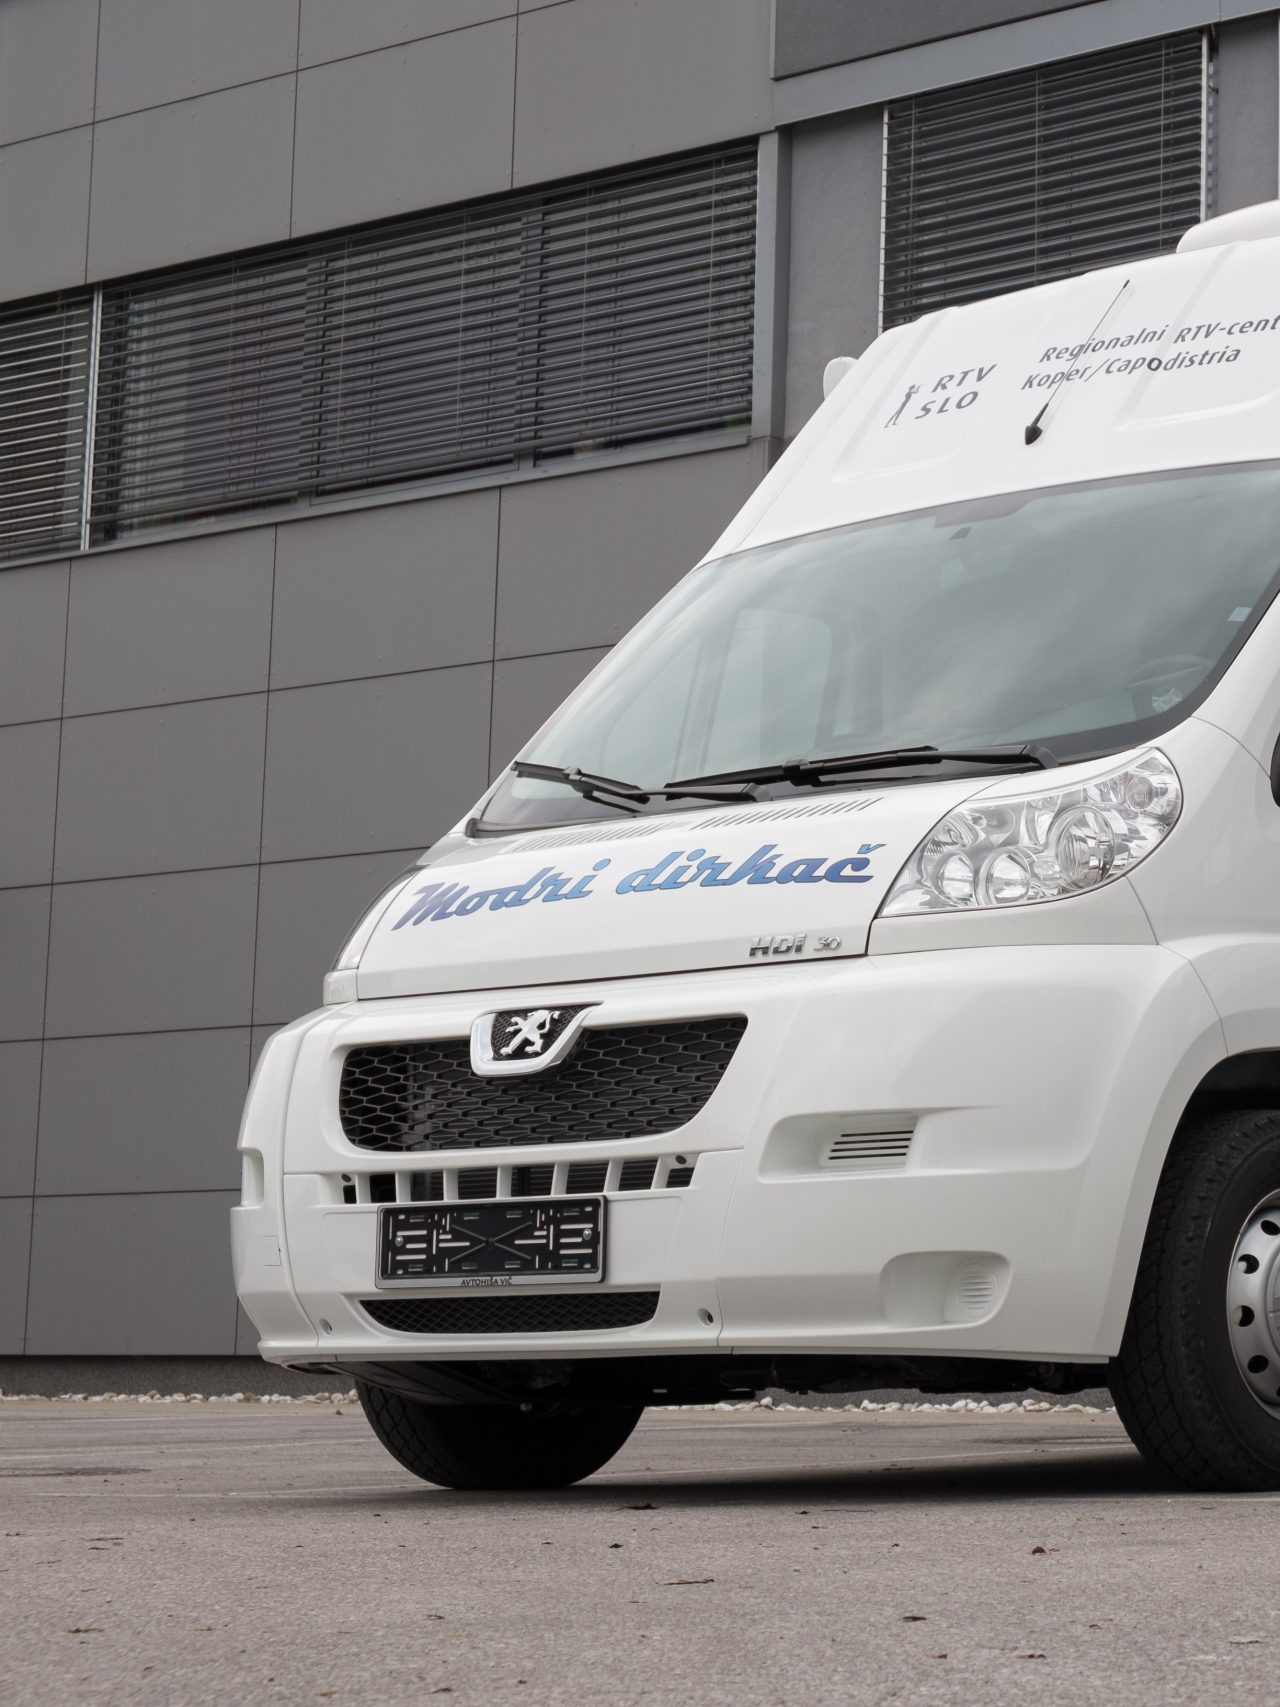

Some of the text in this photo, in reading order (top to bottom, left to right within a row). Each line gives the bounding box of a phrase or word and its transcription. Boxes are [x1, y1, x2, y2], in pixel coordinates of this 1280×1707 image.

[1039, 324, 1170, 364] Regionalni
[931, 363, 998, 393] RTV
[1020, 346, 1242, 391] Koper/Capodistria
[915, 390, 979, 420] SLO
[390, 843, 887, 931] Modri dirkač
